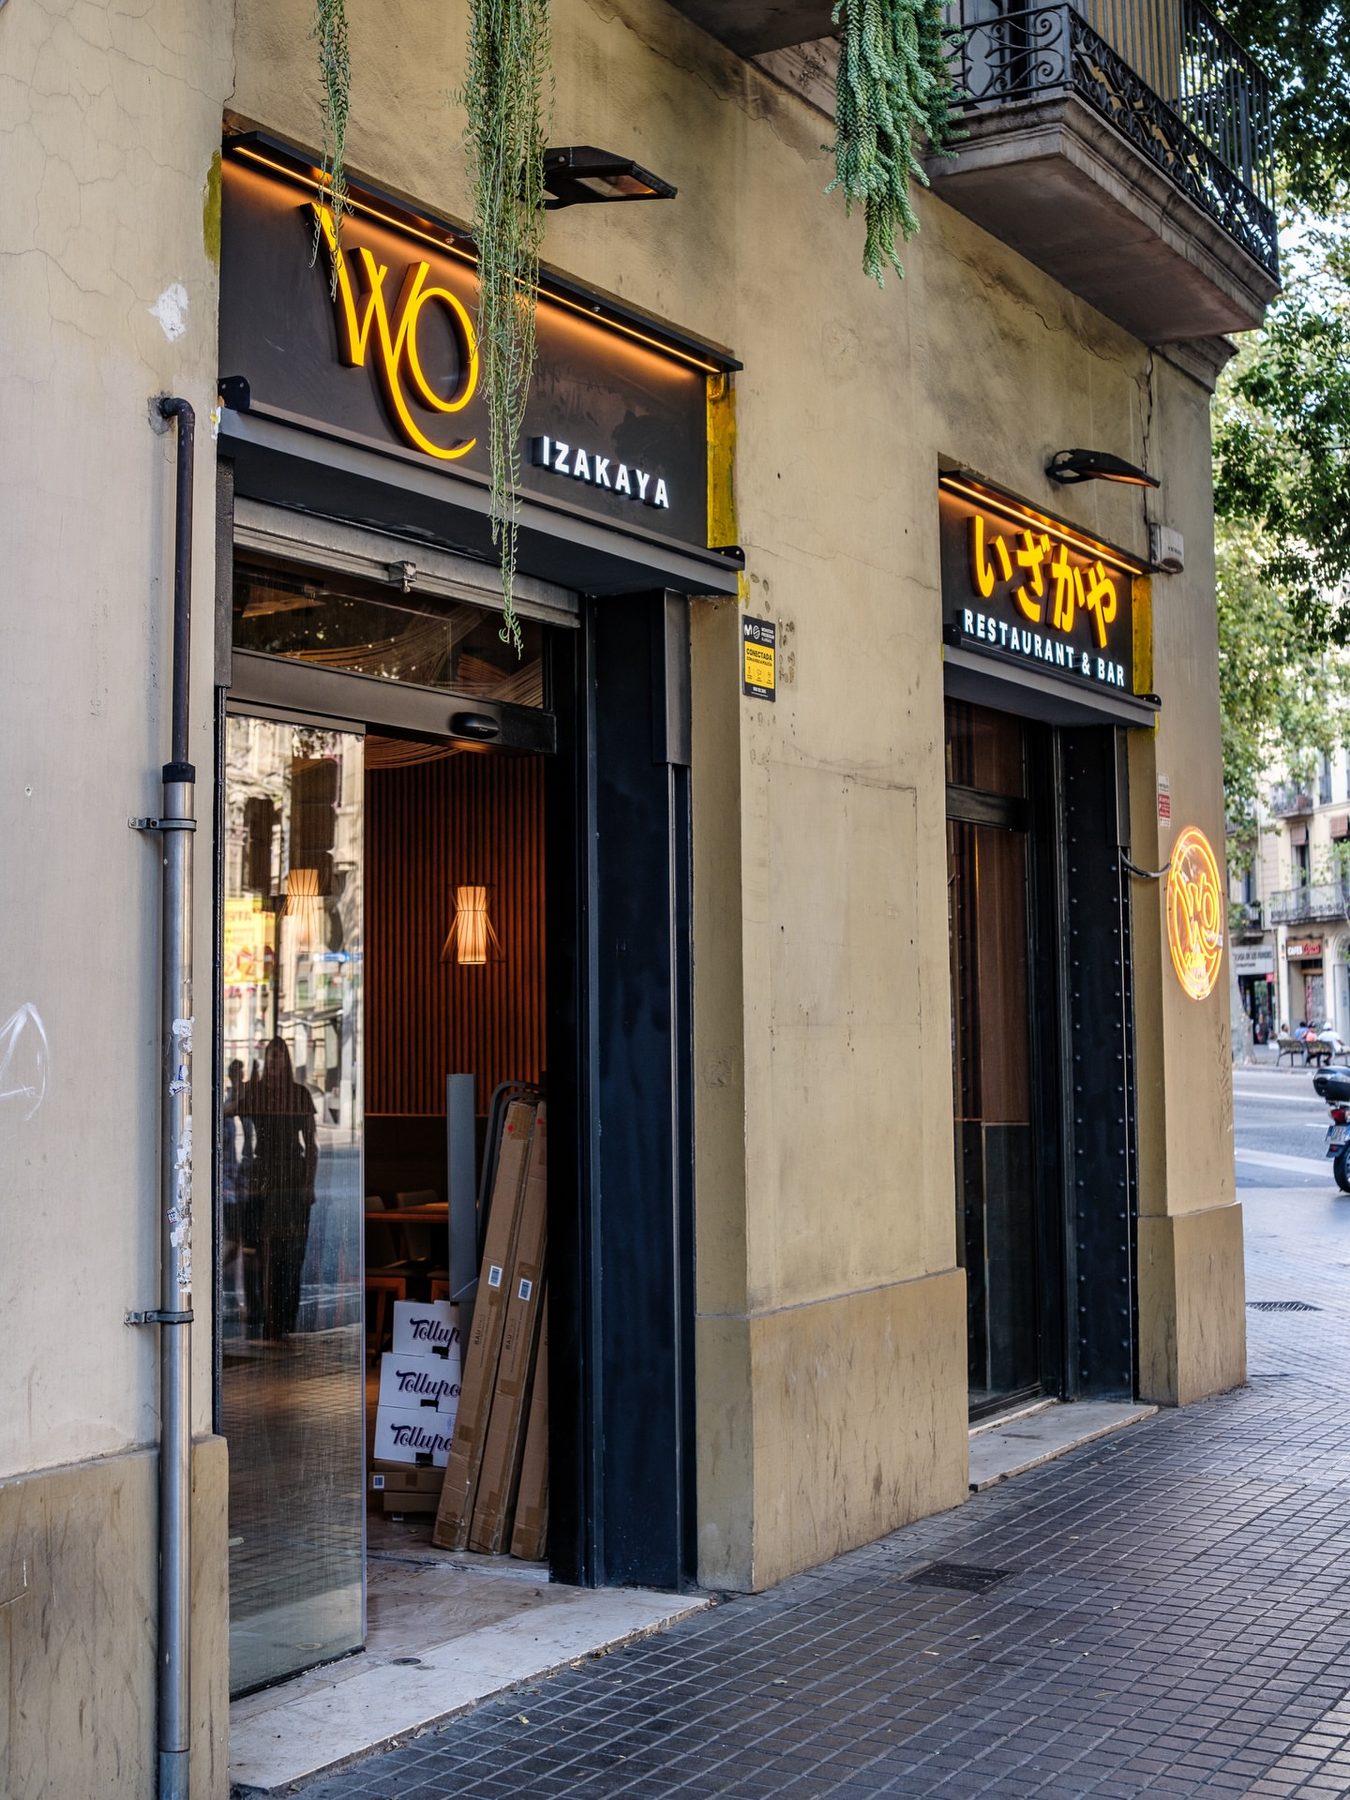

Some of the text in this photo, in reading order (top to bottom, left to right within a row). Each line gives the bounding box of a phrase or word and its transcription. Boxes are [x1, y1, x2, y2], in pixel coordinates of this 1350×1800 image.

[539, 435, 671, 510] IZAKAYA
[974, 514, 1118, 649] いざかや
[746, 647, 772, 661] CONECTADA
[962, 607, 1126, 688] RESTAURANT & BAR
[396, 1370, 461, 1401] Tollupo
